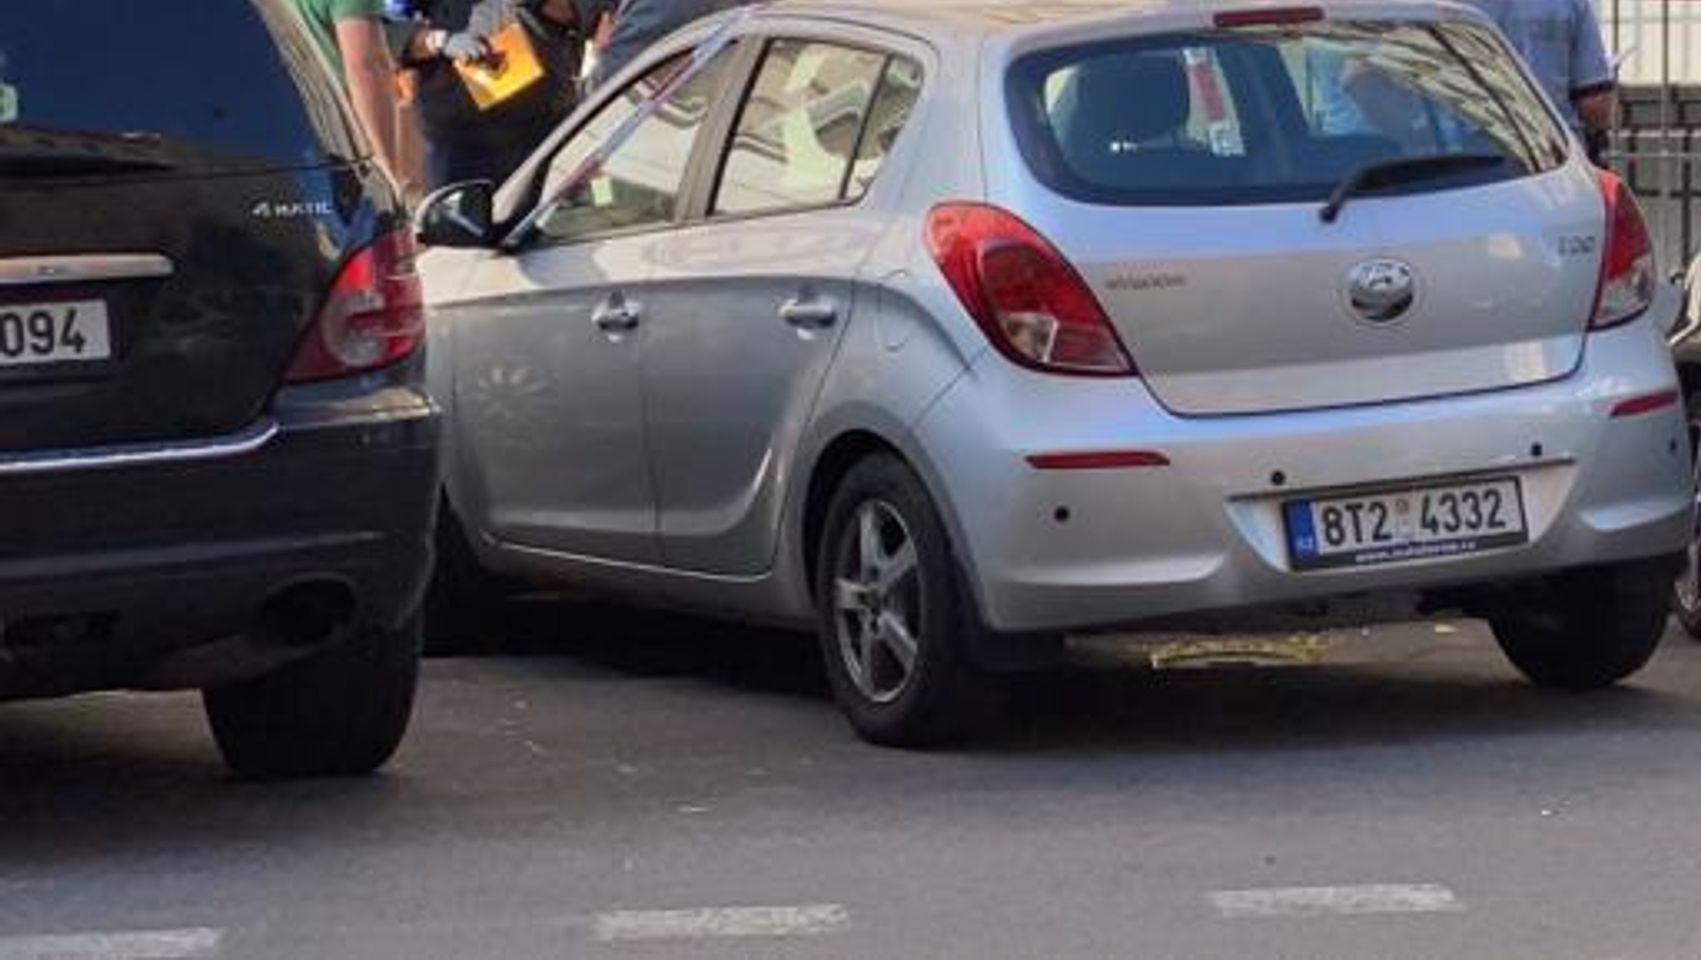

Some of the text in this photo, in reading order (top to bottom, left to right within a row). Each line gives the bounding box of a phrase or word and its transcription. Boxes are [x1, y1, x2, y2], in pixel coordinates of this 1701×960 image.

[0, 306, 86, 359] 094
[1322, 488, 1507, 547] 8T2 4332
